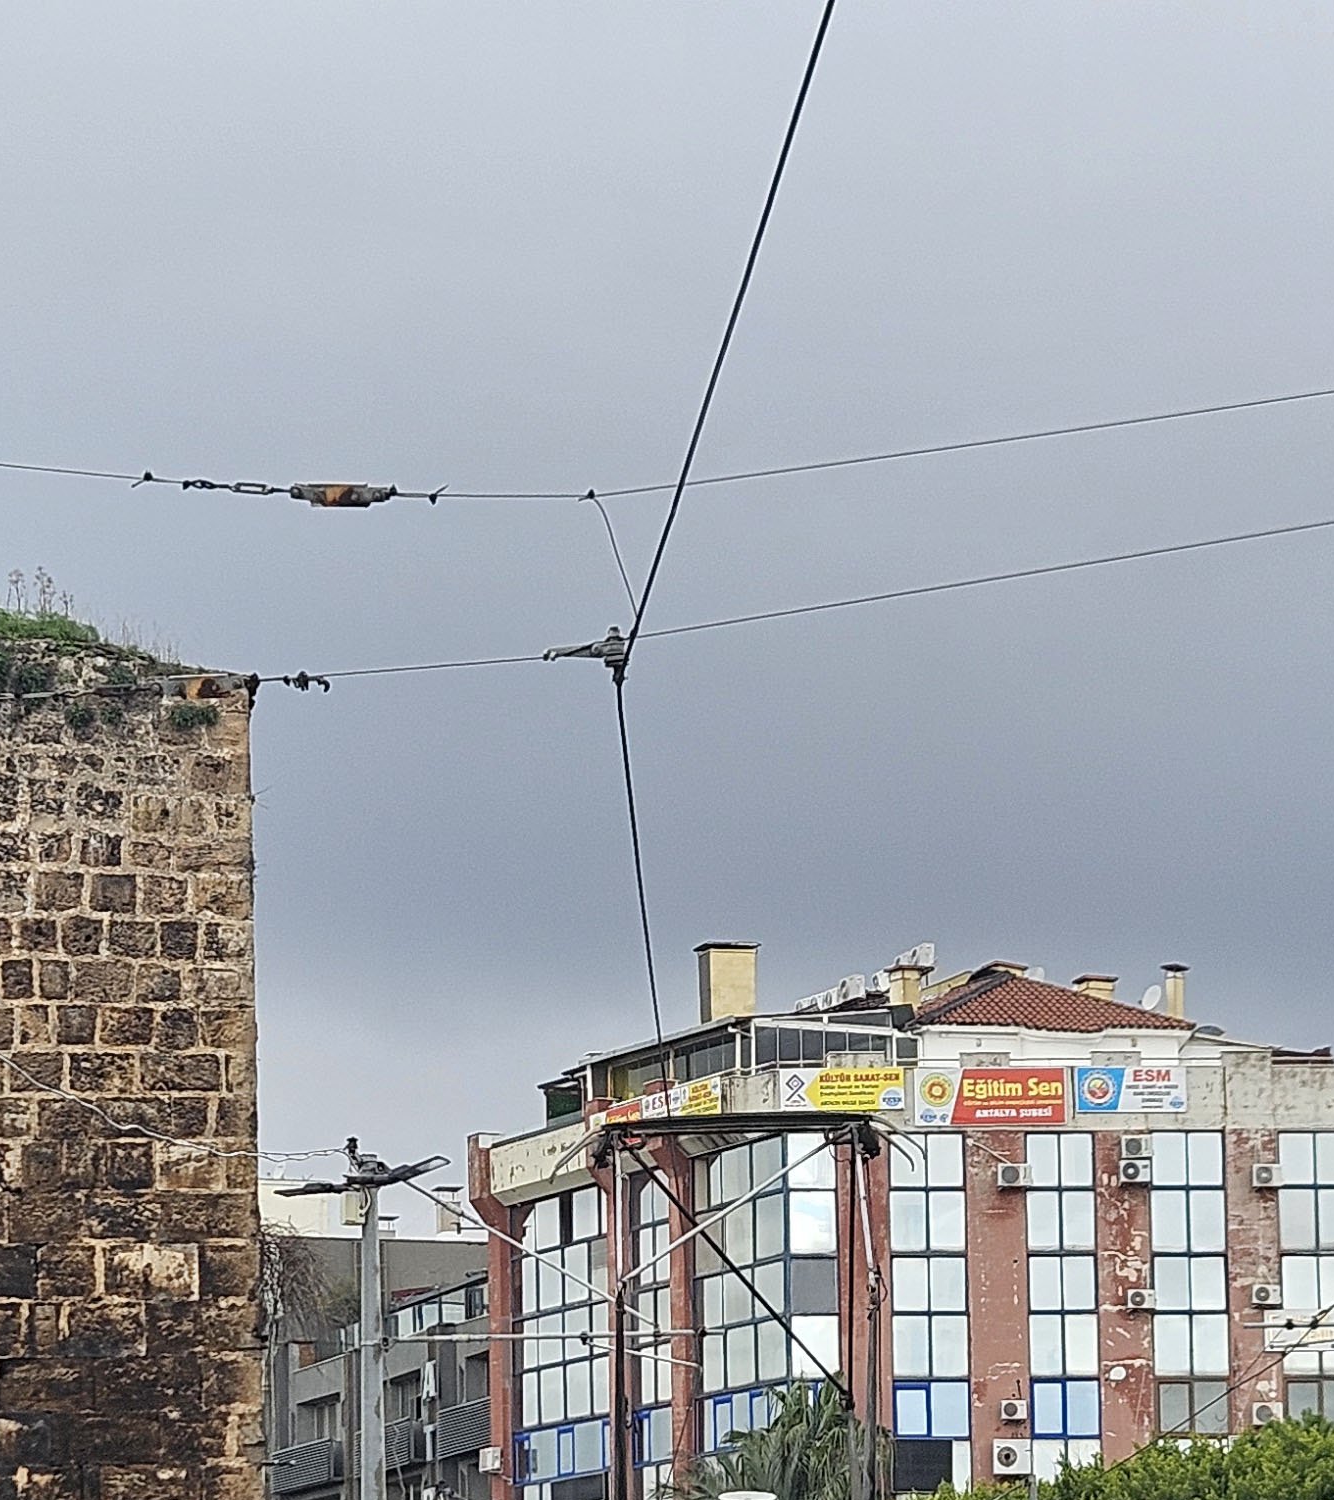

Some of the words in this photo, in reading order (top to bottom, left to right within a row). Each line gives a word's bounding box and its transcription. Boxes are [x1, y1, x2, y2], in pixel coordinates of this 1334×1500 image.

[819, 1072, 851, 1083] KÜLTÜR
[854, 1073, 900, 1082] SANAT-SEN
[1133, 1069, 1171, 1082] ESM
[962, 1078, 1022, 1099] Eğitim
[1027, 1077, 1062, 1096] Sen
